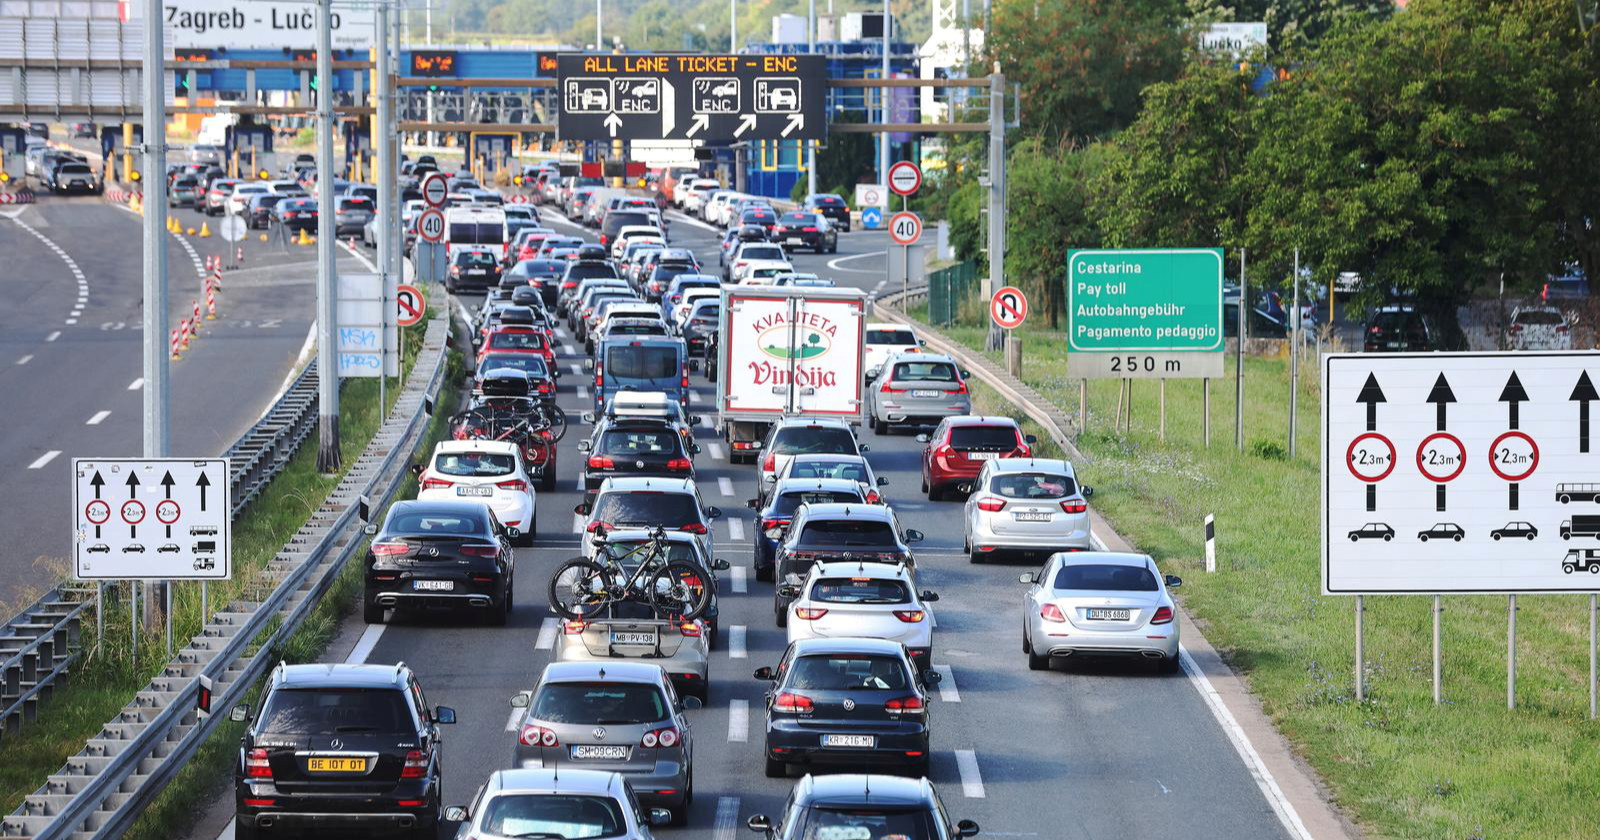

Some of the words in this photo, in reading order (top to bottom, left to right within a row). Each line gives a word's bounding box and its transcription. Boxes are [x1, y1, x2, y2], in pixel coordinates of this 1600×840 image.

[165, 6, 245, 33] Zagreb
[272, 8, 341, 30] Lučo
[585, 57, 617, 72] ALL
[625, 57, 669, 72] LANE
[677, 57, 738, 72] TICKET
[764, 57, 797, 72] ENC
[622, 99, 651, 112] ENC
[702, 99, 731, 112] ENC
[425, 217, 440, 233] 40
[896, 221, 914, 236] 40
[1077, 261, 1142, 274] Cestarina
[1077, 282, 1101, 298] Pay
[1106, 282, 1126, 295] toll
[1077, 303, 1186, 319] Autobahngebühr
[752, 311, 838, 337] KVALITETA
[1077, 325, 1152, 340] Pagamento
[1156, 324, 1216, 340] pedaggio
[1110, 356, 1155, 372] 250
[1165, 360, 1181, 372] m
[748, 360, 836, 388] Vindija
